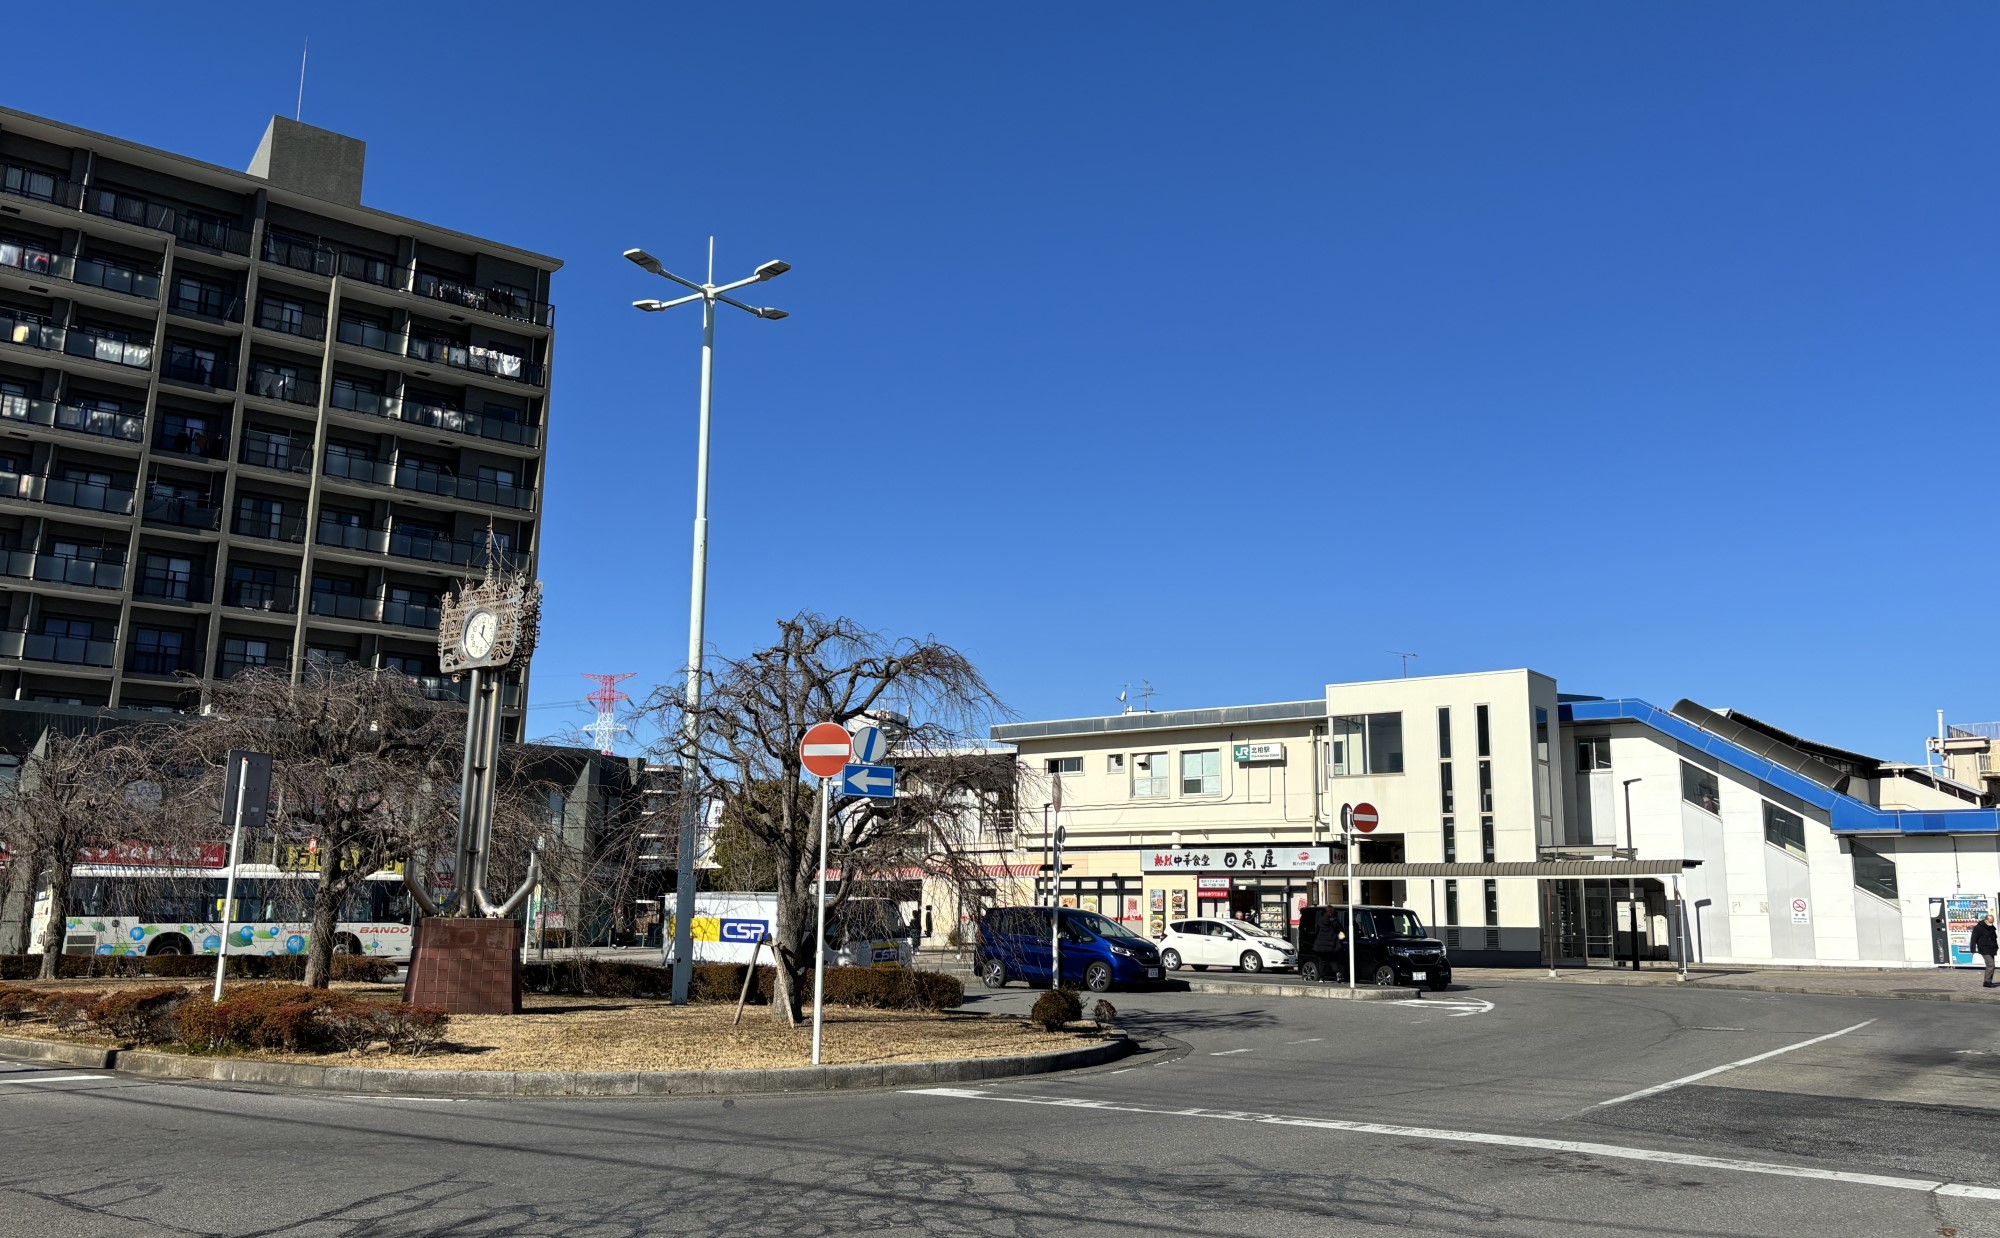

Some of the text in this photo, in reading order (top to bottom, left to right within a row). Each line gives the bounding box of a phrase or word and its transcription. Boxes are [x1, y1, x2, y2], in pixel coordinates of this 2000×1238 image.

[1235, 746, 1249, 756] JR
[1251, 746, 1270, 754] 北柏駅
[1154, 849, 1277, 869] 熱烈中華食堂 日高屋
[360, 926, 410, 934] BANDO
[722, 922, 765, 939] CSP
